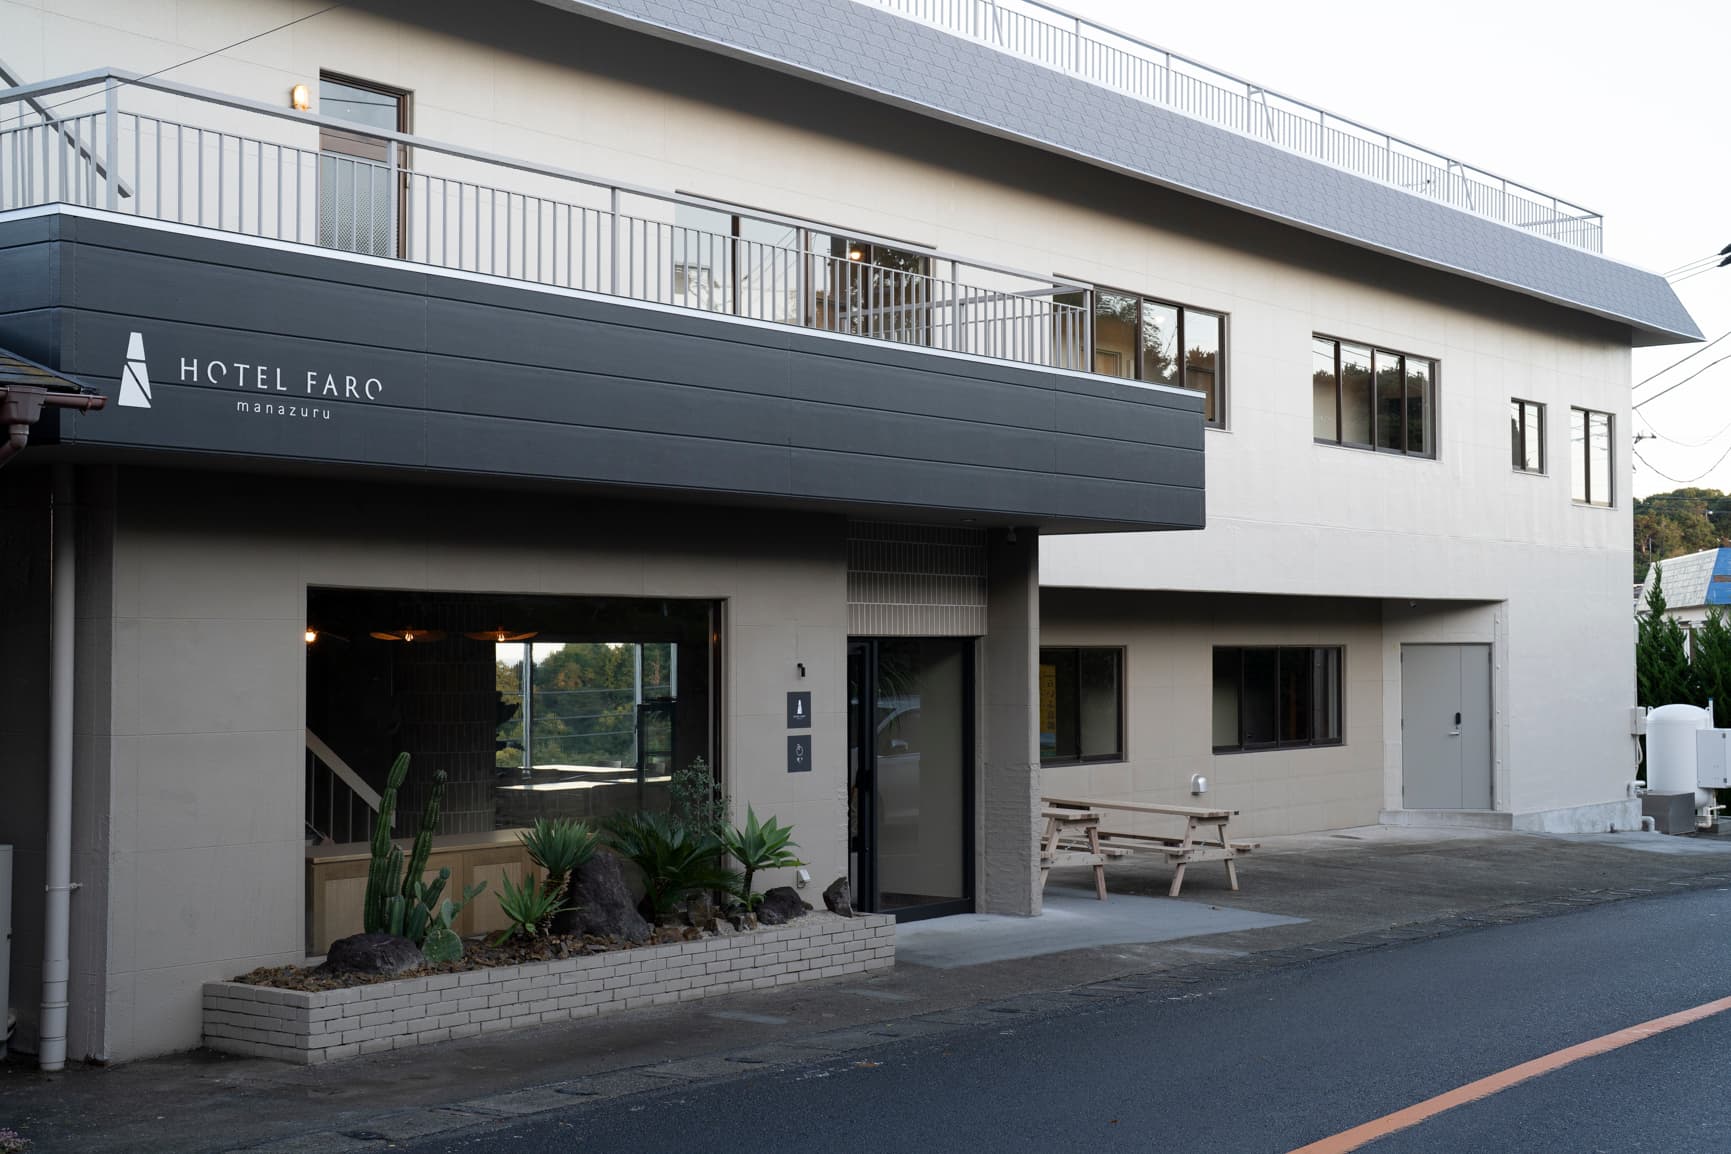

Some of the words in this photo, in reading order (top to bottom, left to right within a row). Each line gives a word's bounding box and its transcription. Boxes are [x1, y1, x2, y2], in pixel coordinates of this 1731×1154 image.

[180, 357, 288, 391] HOTEL
[307, 371, 383, 401] FARO
[236, 400, 331, 420] manazuru
